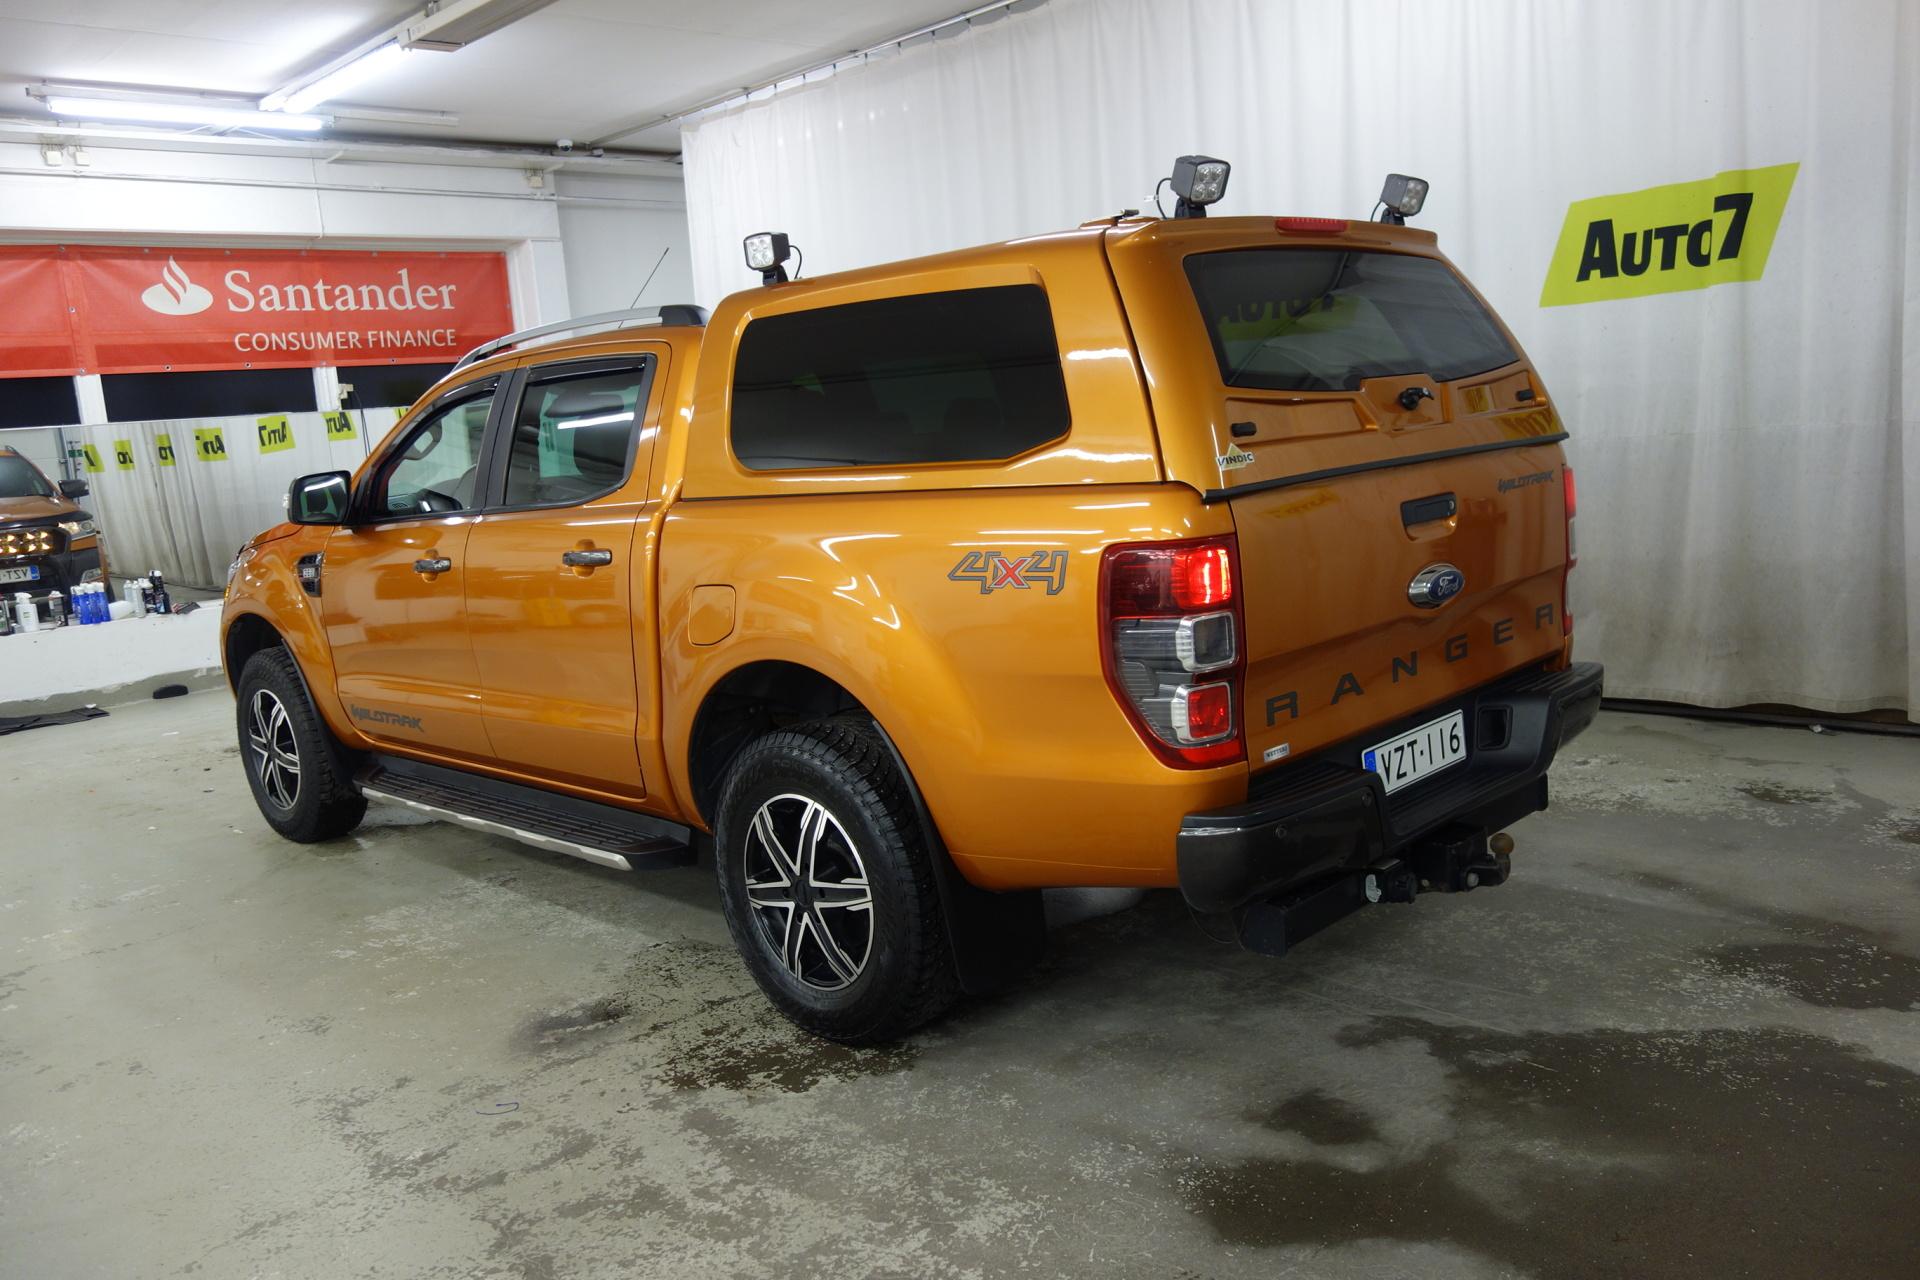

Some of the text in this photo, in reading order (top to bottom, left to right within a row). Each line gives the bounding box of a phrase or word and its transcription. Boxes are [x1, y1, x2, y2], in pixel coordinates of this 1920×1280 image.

[1576, 192, 1754, 282] AUTO7
[224, 268, 456, 312] Santander
[234, 329, 457, 352] CONSUMER FINANCE
[1217, 453, 1253, 466] VINDIC
[1438, 576, 1459, 596] Ford
[1266, 604, 1554, 727] RANGER
